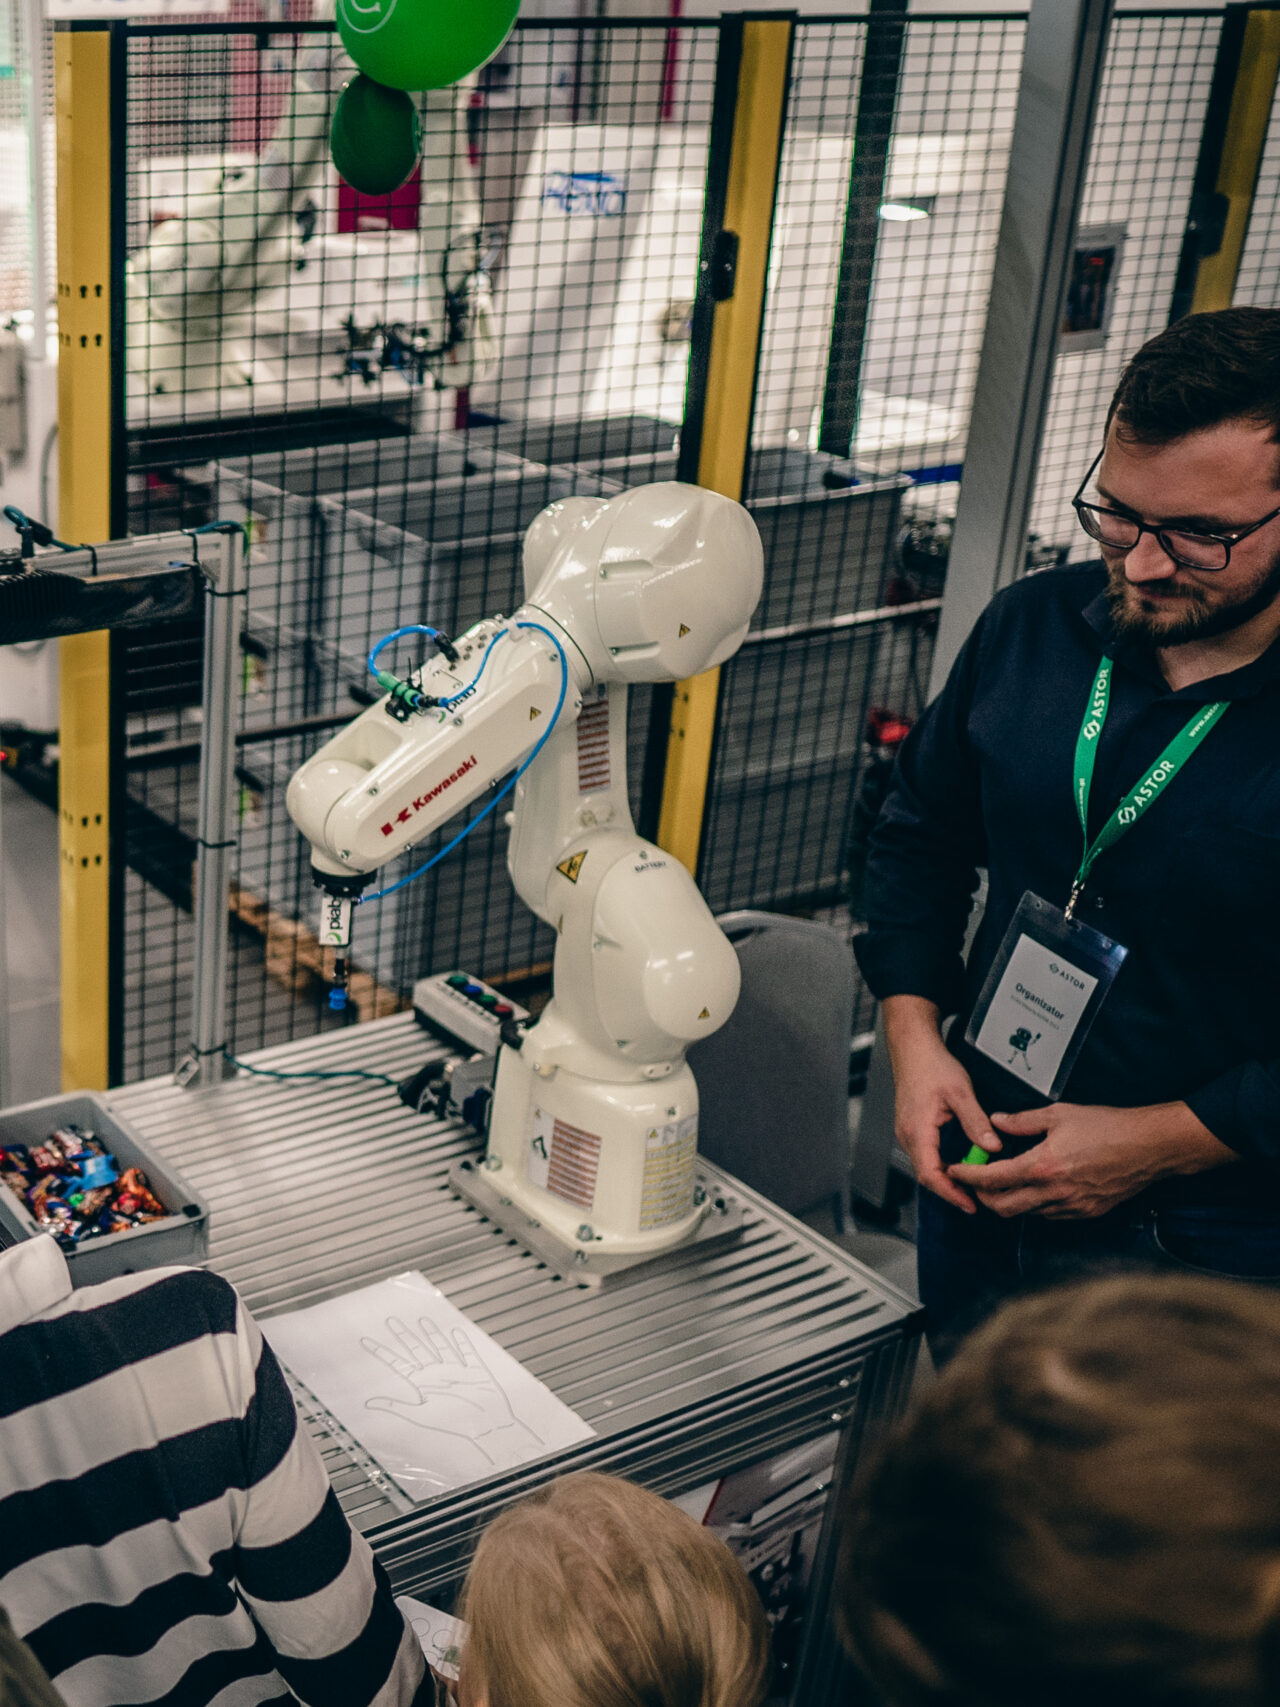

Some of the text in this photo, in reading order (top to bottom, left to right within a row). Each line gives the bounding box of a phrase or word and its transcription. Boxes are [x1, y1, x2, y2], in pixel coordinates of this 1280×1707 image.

[1091, 668, 1109, 718] ASTOR
[412, 754, 478, 812] Kawasaki
[1133, 759, 1176, 808] ASTOR
[327, 898, 344, 930] piab
[1015, 982, 1065, 1021] Organizator
[1060, 970, 1086, 990] ASTOR
